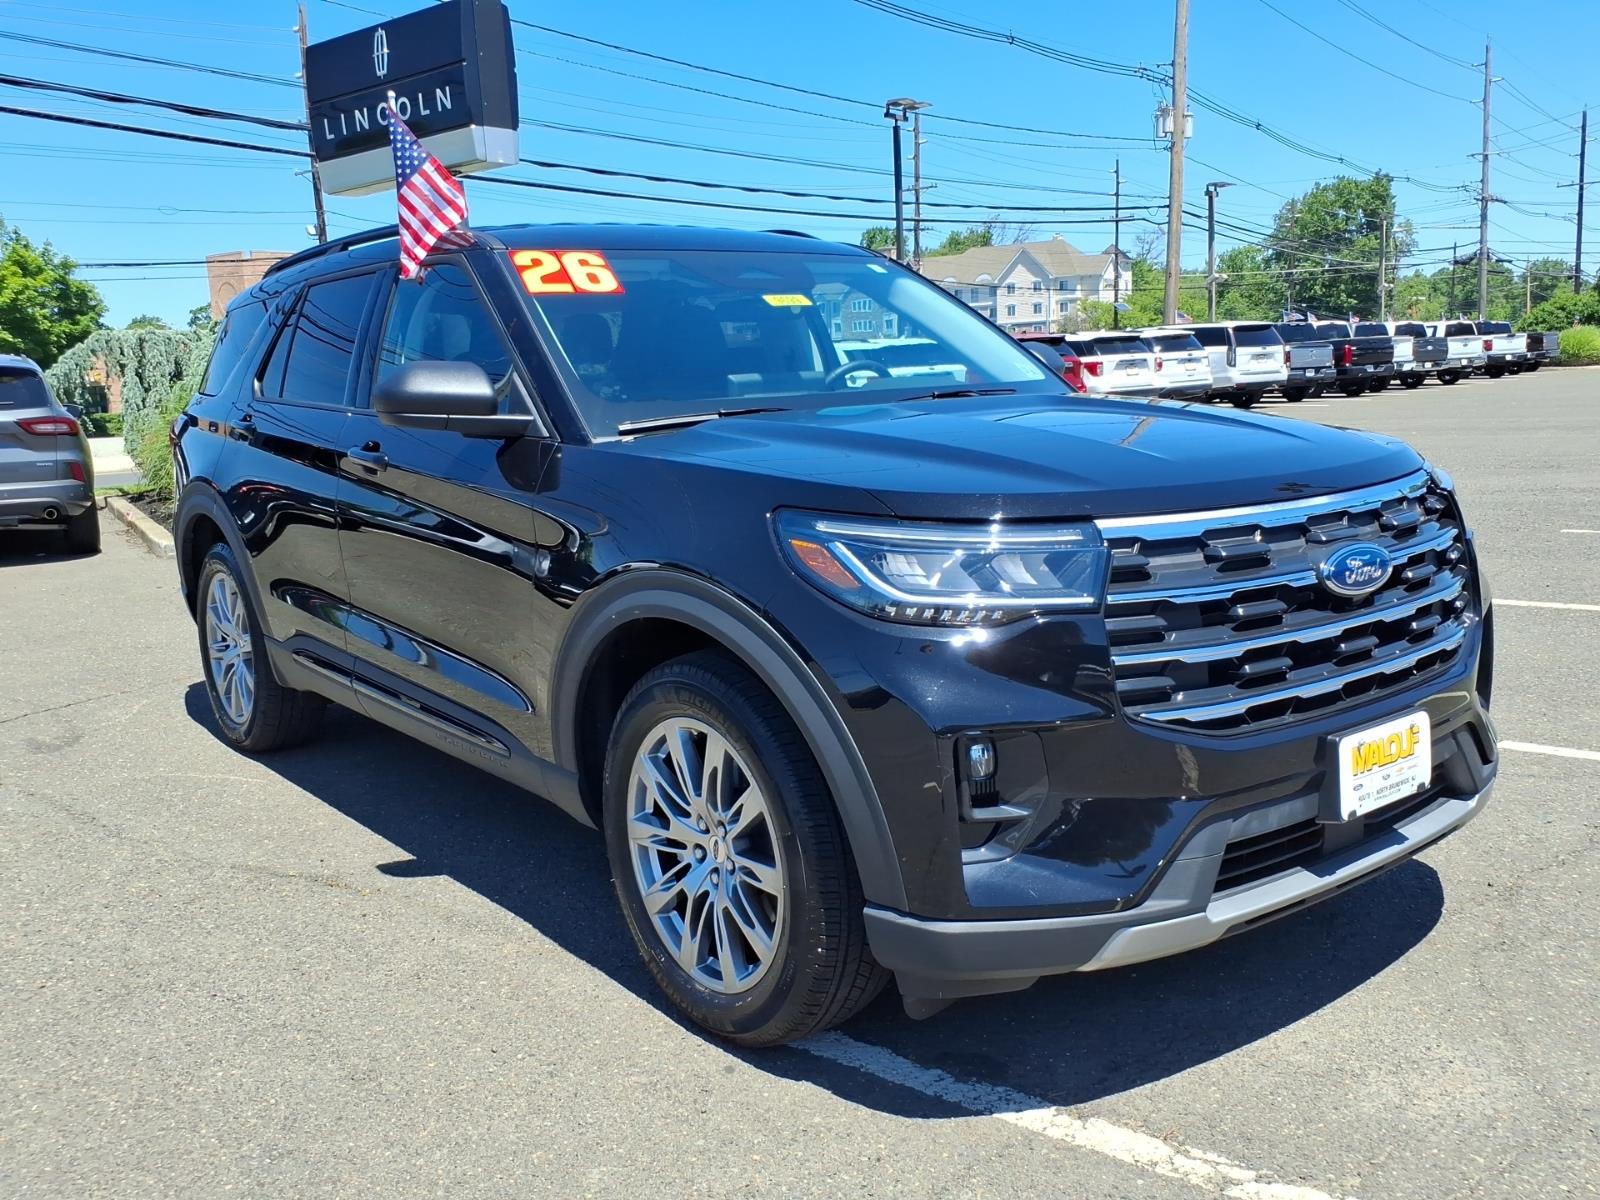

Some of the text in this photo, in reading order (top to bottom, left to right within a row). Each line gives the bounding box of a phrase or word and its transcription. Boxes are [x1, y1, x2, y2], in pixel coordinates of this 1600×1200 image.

[324, 86, 452, 140] LINCOLN
[513, 249, 619, 293] 26
[1345, 555, 1382, 584] Ford
[1351, 724, 1420, 777] MALOUF
